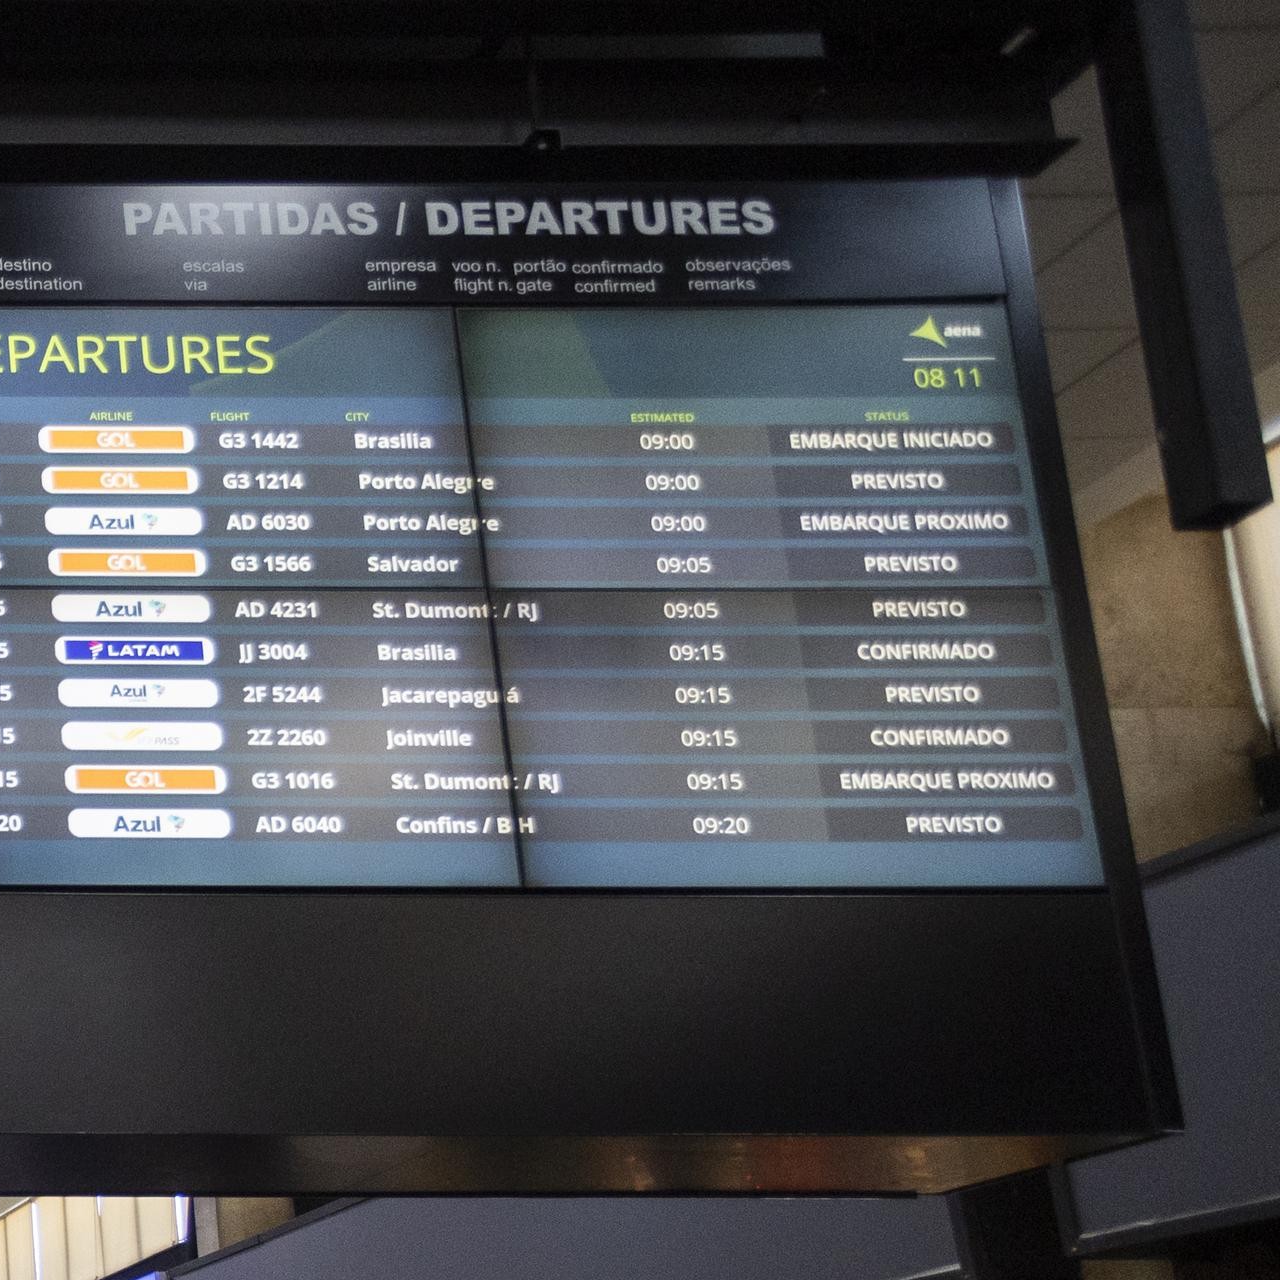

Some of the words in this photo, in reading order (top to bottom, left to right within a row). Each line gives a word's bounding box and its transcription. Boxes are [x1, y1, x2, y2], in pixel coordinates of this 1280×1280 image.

[123, 202, 378, 236] PARTIDAS
[395, 202, 407, 236] /
[426, 200, 775, 236] DEPARTURES
[944, 325, 981, 337] aena
[89, 412, 133, 421] AIRLINE
[210, 412, 249, 421] FLIGHT
[345, 412, 370, 422] CITY
[630, 413, 695, 422] ESTIMATED
[864, 411, 909, 421] STATUS
[96, 432, 135, 448] GOL
[219, 433, 243, 449] G3
[246, 433, 299, 449] 1442
[354, 432, 432, 450] Brasilia
[640, 432, 694, 451] 09:00
[789, 430, 899, 452] EMBARQUE
[902, 430, 993, 449] INICIADO
[107, 644, 180, 658] LATAM
[238, 644, 254, 664] JJ
[257, 643, 308, 661] 3004
[377, 644, 456, 662] Brasilia
[669, 643, 725, 661] 09:15
[857, 642, 995, 661] CONFIRMADO
[113, 816, 162, 833] Azul
[255, 816, 286, 834] AD
[290, 816, 341, 834] 6040
[395, 815, 477, 834] Confins
[692, 817, 749, 835] 09:20
[906, 816, 1003, 834] PREVISTO
